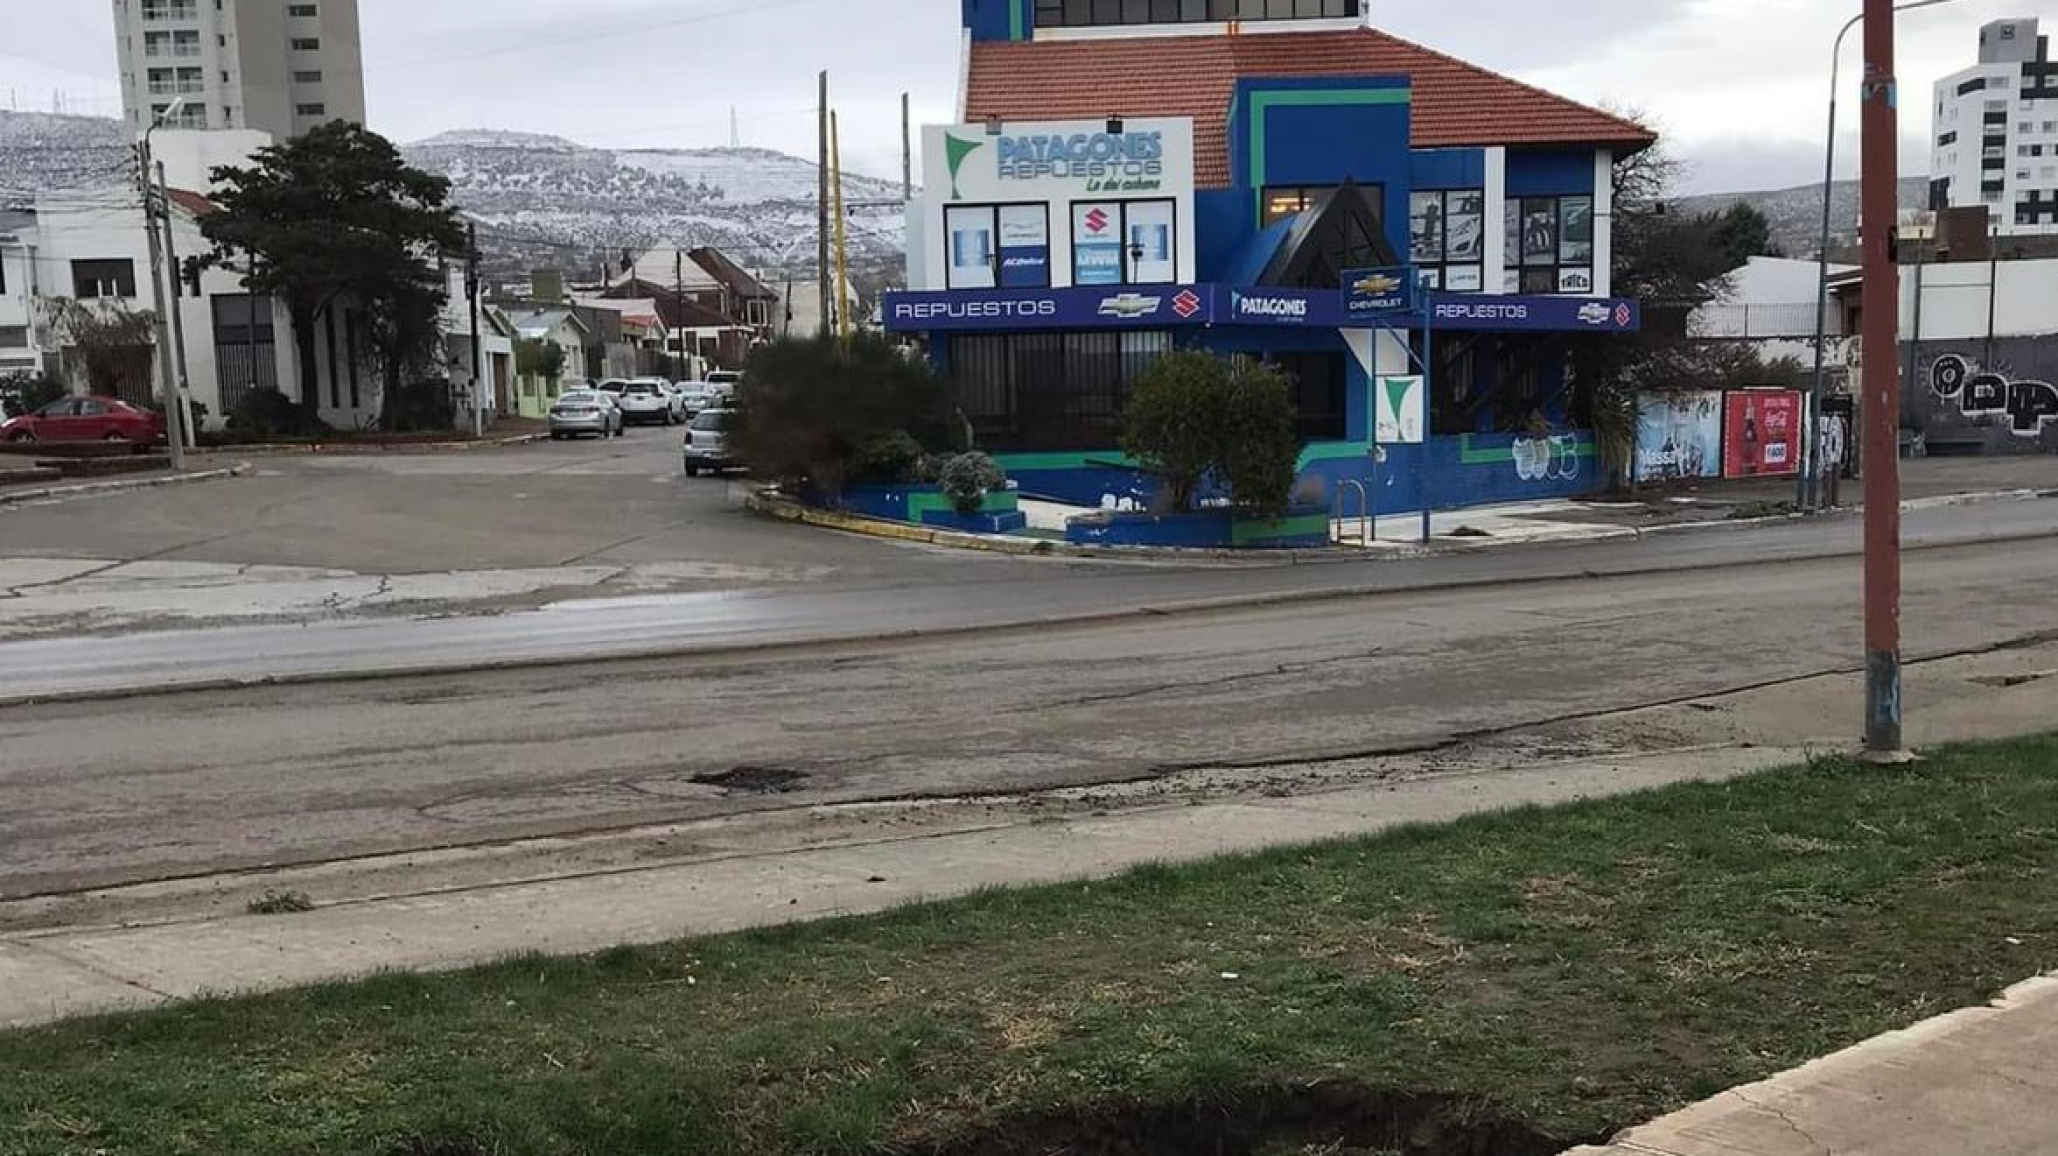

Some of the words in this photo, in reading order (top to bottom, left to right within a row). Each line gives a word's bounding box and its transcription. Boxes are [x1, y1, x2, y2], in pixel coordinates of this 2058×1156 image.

[998, 132, 1163, 163] PATAGONES
[998, 160, 1163, 179] REPUESTOS
[895, 300, 1056, 318] REPUESTOS
[1240, 297, 1307, 316] PATAGONES
[1349, 297, 1402, 311] CHEVROLET
[1435, 304, 1528, 318] REPUESTOS
